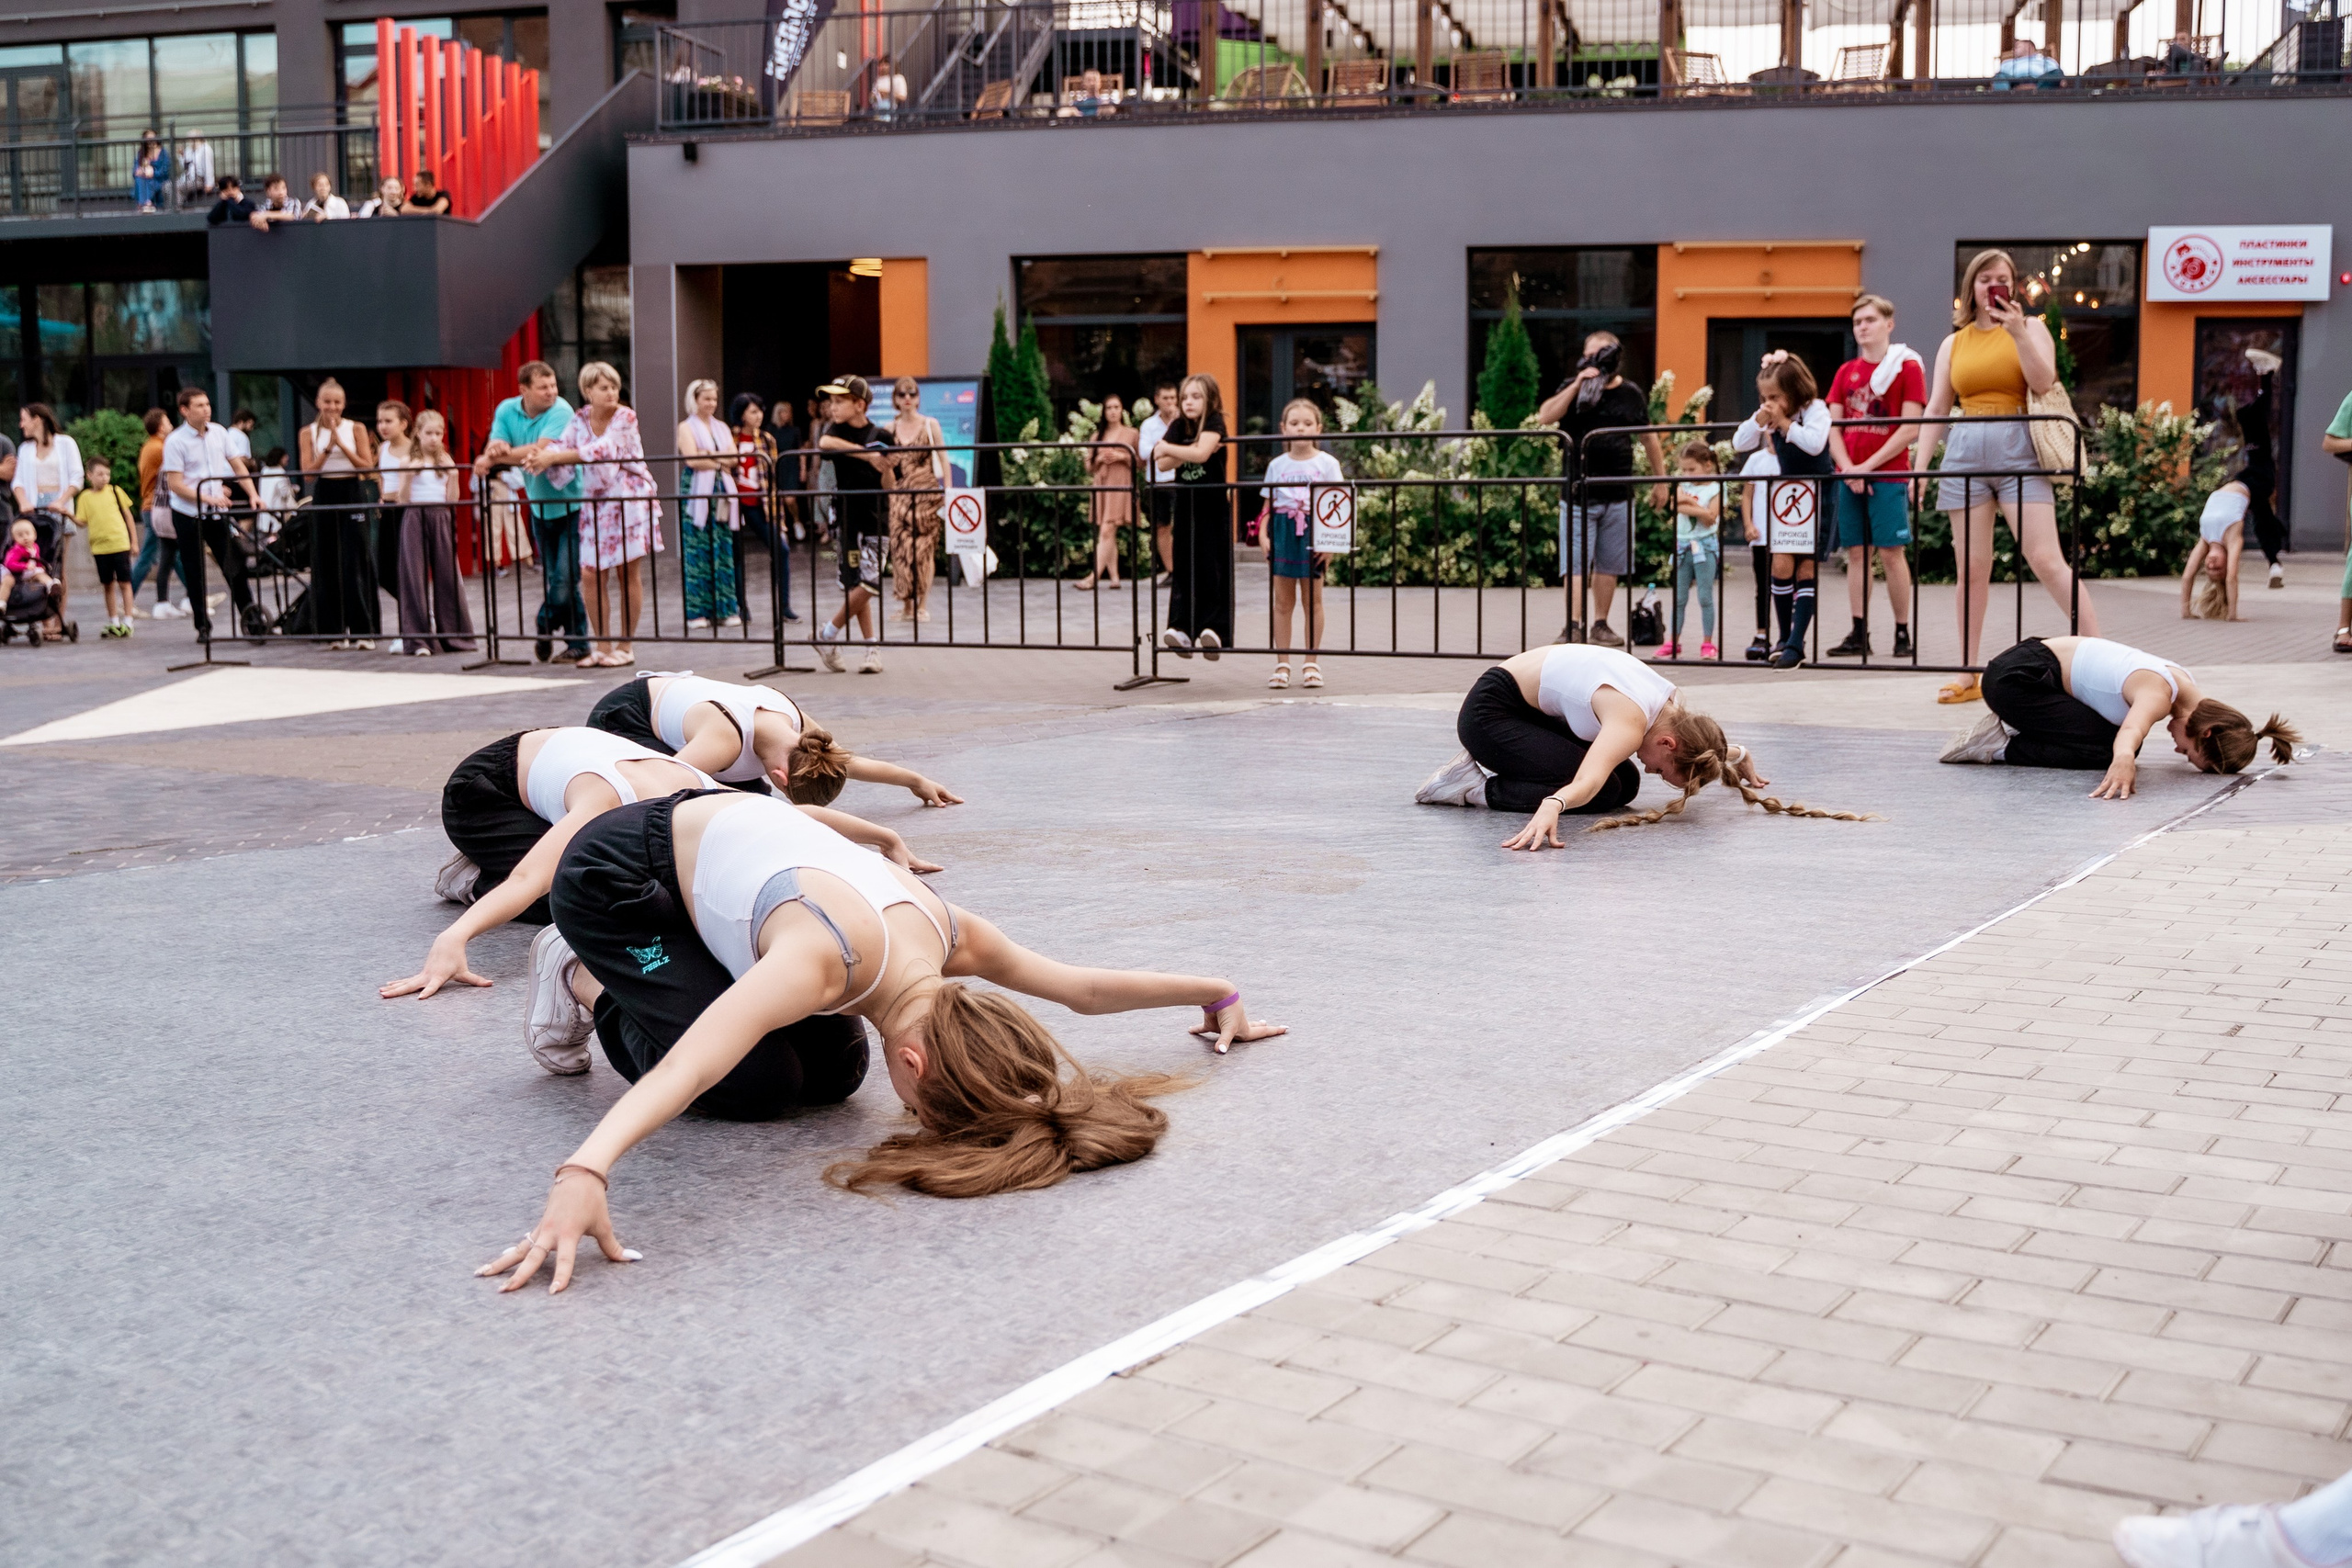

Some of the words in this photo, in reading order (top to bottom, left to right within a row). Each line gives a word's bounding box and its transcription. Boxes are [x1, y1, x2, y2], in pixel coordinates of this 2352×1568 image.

[2239, 239, 2308, 249] ПЛАСТИНКИ
[2232, 258, 2314, 267] ИНСТРУМЕНТЫ
[2237, 276, 2309, 285] АКСЕССУАРЫ
